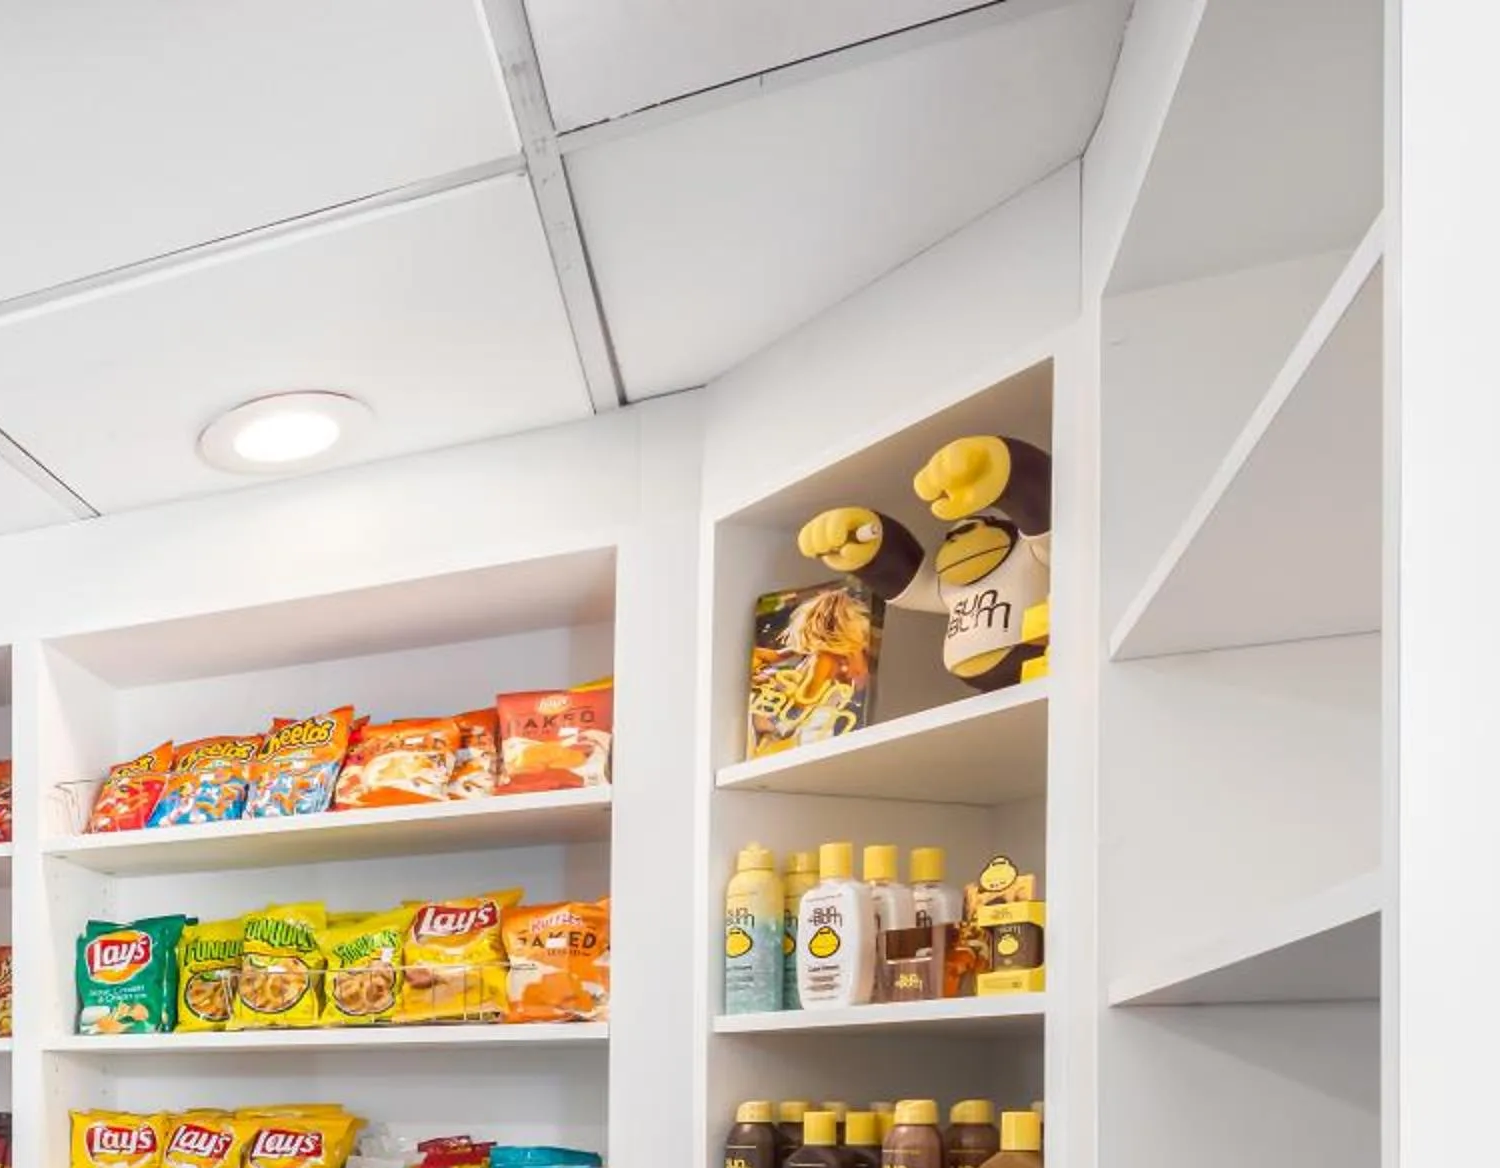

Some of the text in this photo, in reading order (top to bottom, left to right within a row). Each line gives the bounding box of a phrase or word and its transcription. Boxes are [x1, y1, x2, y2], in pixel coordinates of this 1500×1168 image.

[418, 904, 494, 937] Lay's
[94, 936, 147, 973] Lay's
[91, 1126, 155, 1156] Lay's
[168, 1124, 231, 1159] Lay's
[250, 1130, 321, 1159] Lay's
